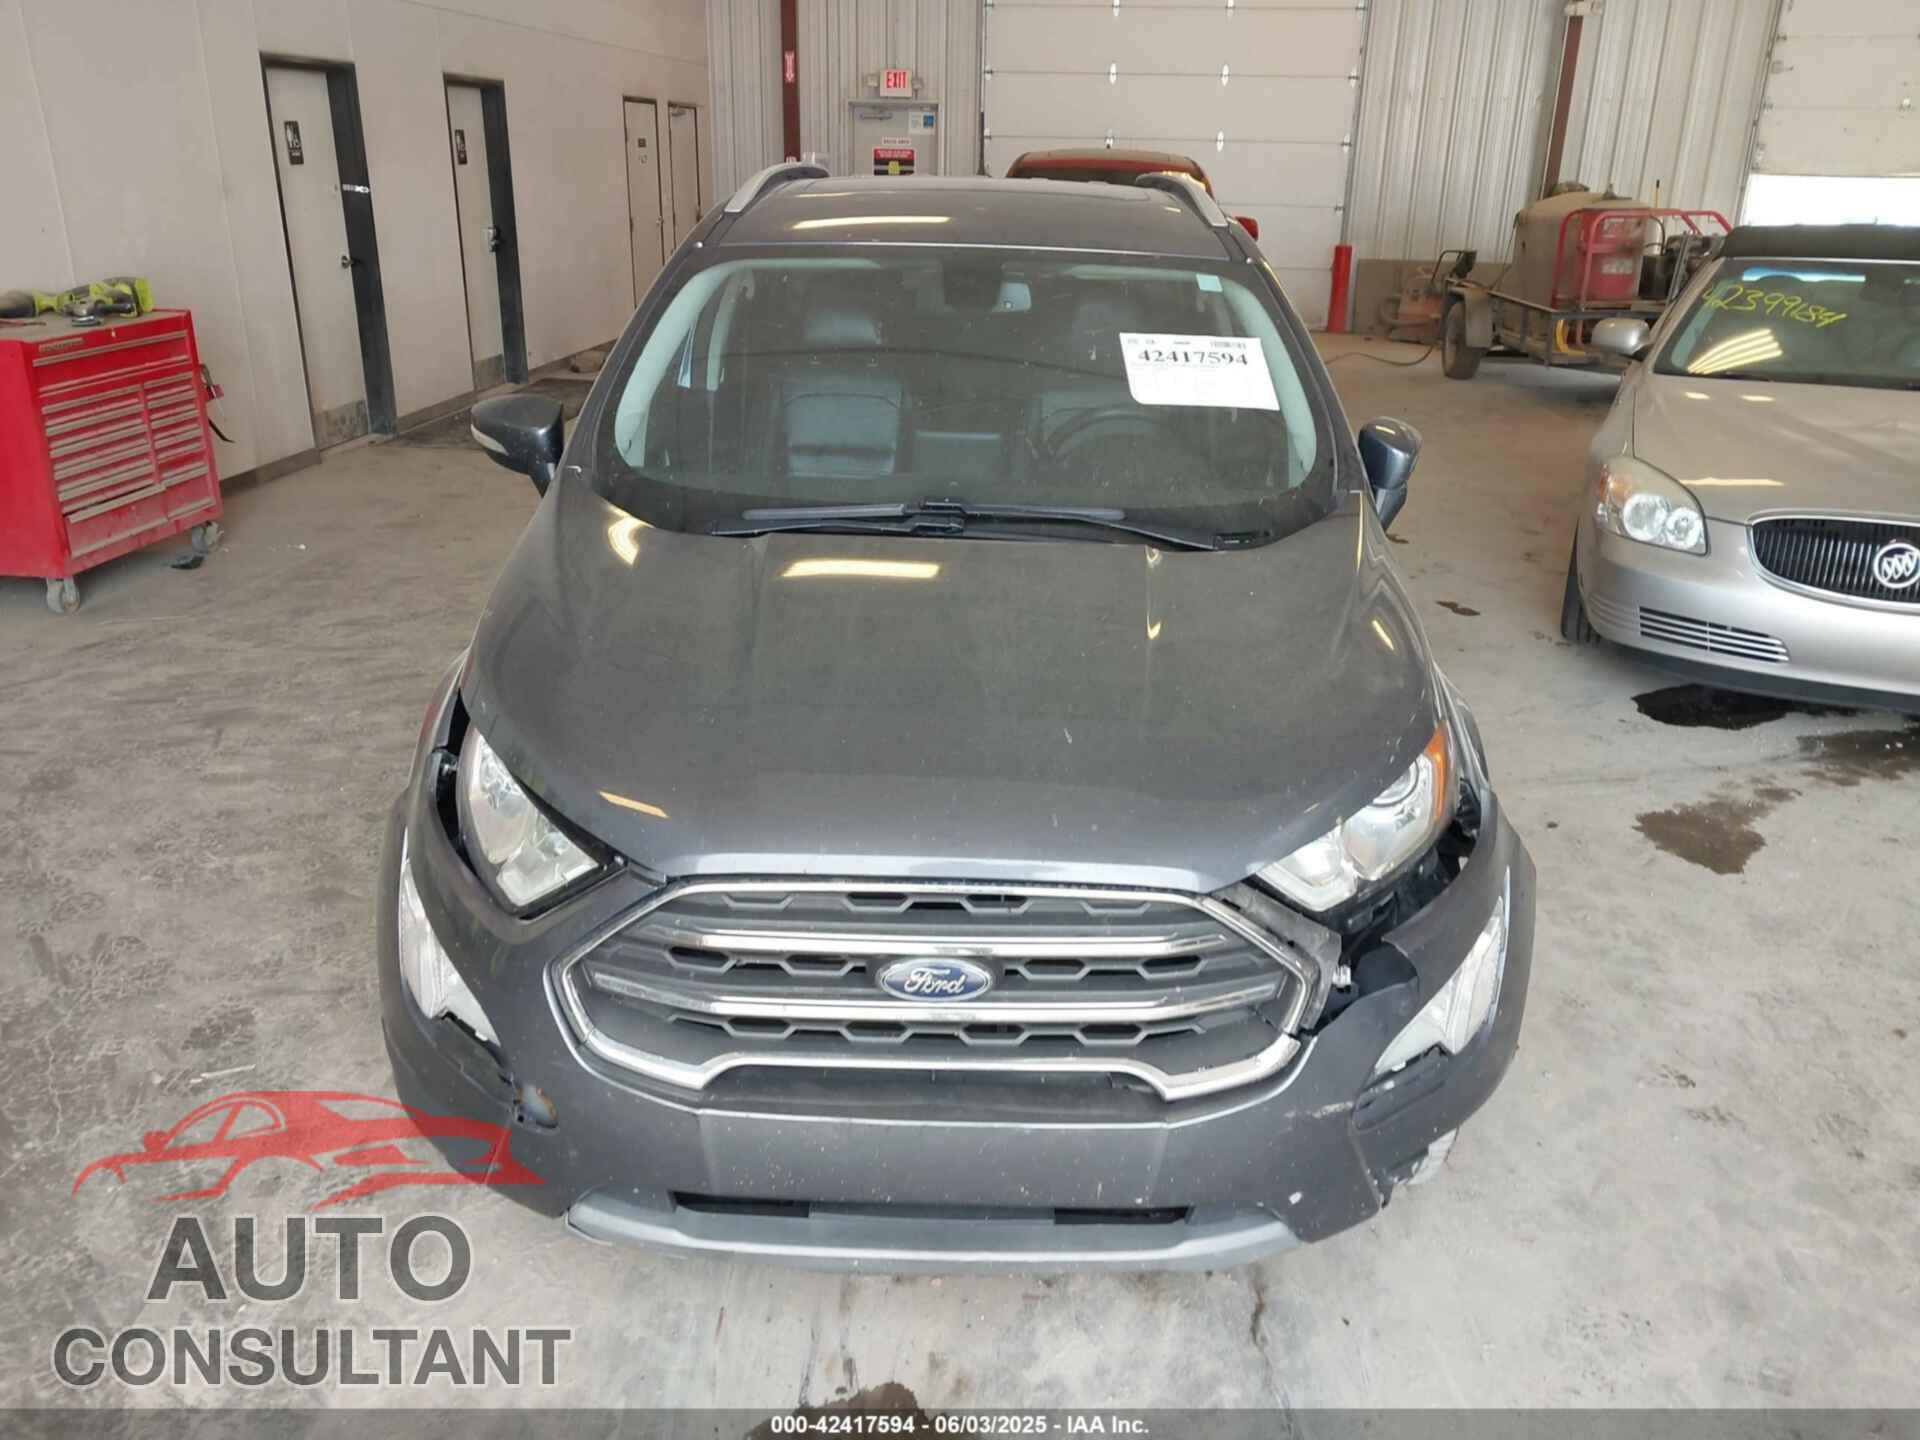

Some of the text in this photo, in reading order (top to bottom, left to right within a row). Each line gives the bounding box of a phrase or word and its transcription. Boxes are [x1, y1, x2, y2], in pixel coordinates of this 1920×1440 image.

[886, 71, 906, 88] EXIT
[1138, 349, 1248, 365] 42417594
[904, 967, 965, 993] Ford
